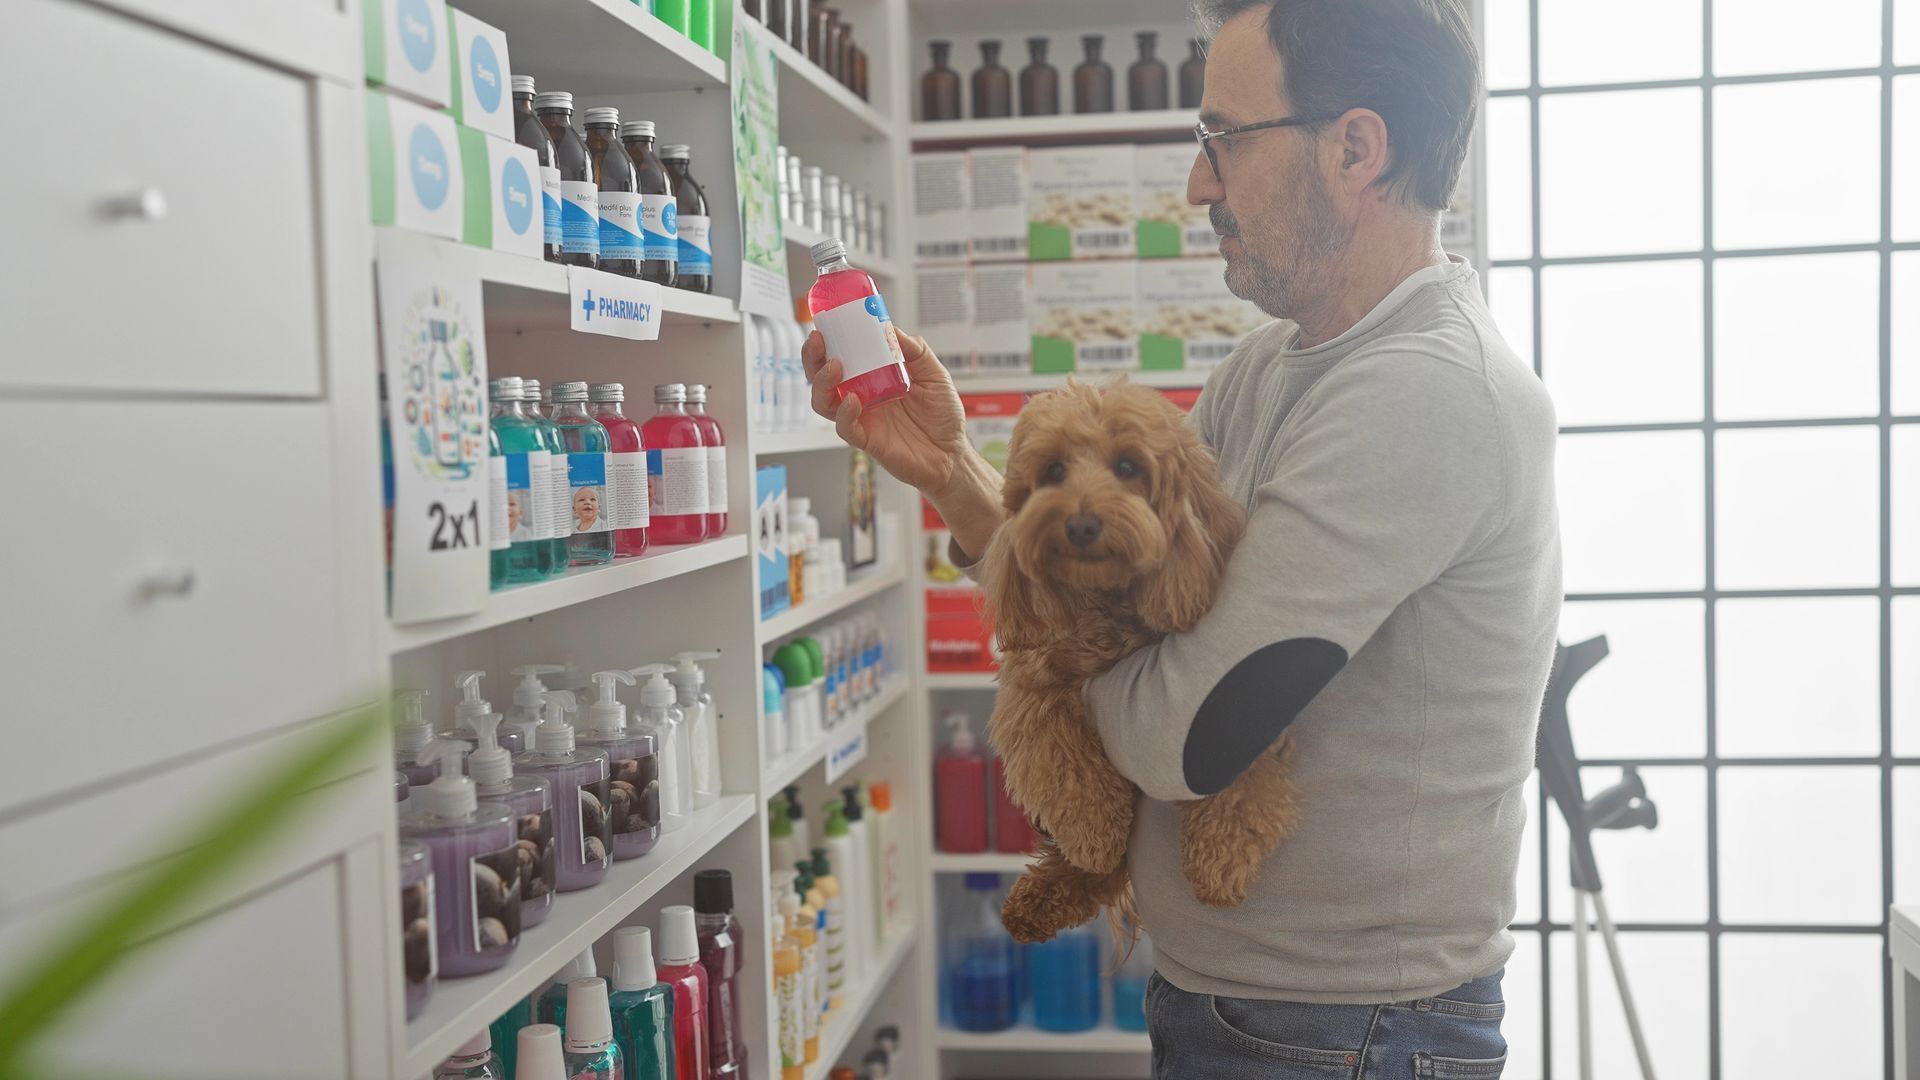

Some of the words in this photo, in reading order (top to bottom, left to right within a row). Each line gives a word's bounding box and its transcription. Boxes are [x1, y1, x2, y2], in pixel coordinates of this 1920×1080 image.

[477, 63, 496, 88] 5mg
[509, 185, 528, 209] 5mg
[619, 205, 632, 213] plus
[599, 297, 651, 322] PHARMACY
[428, 499, 480, 551] 2x1
